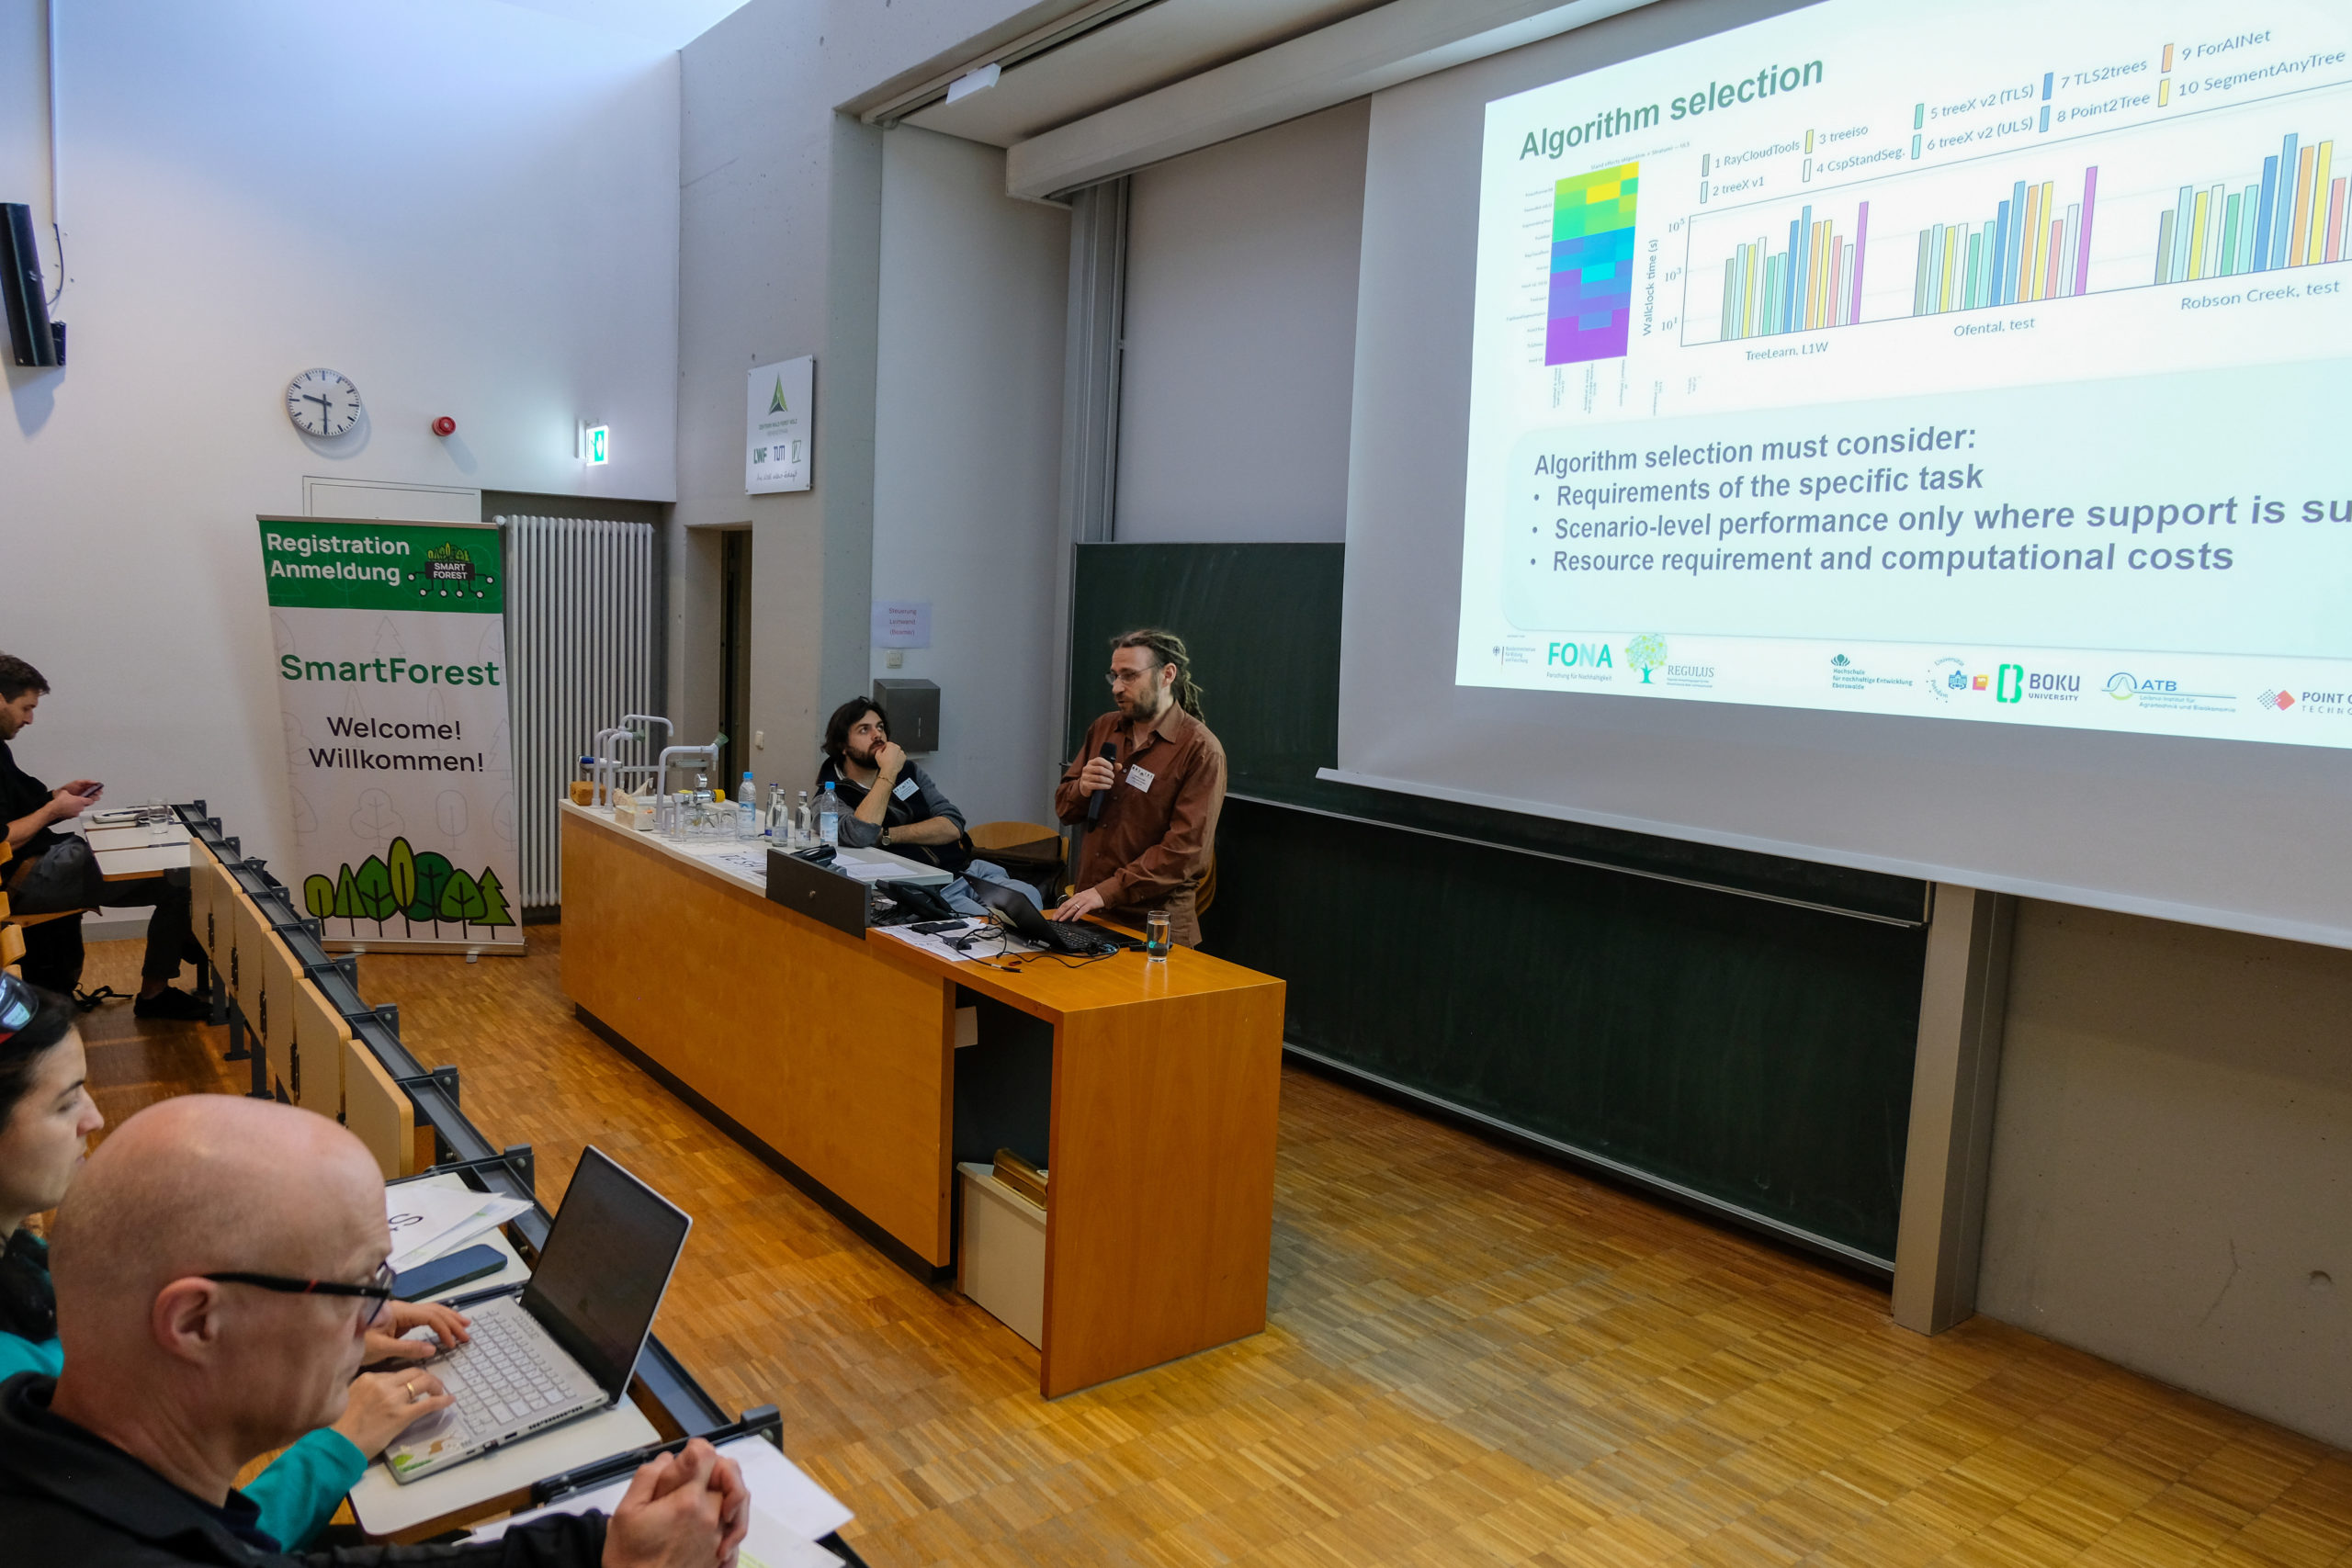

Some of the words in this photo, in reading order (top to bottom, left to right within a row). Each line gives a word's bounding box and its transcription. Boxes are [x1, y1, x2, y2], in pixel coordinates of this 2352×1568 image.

[2182, 48, 2191, 61] 9
[2197, 29, 2272, 57] ForAINet
[2061, 75, 2070, 88] 7
[2074, 58, 2148, 86] TLS2trees
[2178, 82, 2199, 96] 10
[2203, 49, 2346, 90] SegmentAnyTree
[1519, 103, 1659, 161] Algorithm
[1669, 59, 1824, 121] selection
[1930, 107, 1938, 119] 5
[1941, 97, 1976, 117] treeX
[1980, 93, 1996, 107] v2
[2000, 84, 2034, 105] (TLS)
[2057, 109, 2066, 122] 8
[2071, 92, 2151, 120] Point2Tree
[1819, 133, 1826, 144] 3
[1829, 124, 1869, 143] treeiso
[1928, 139, 1936, 151] 6
[1939, 130, 1973, 149] treeX
[1976, 126, 1993, 140] v2
[1996, 116, 2033, 138] (ULS)
[1714, 158, 1720, 169] 1
[1724, 139, 1800, 167] RayCloudTools
[1816, 163, 1824, 174] 4
[1827, 147, 1905, 174] CspStandSeg.
[1713, 186, 1719, 197] 2
[1722, 177, 1748, 196] treeX
[1750, 176, 1764, 189] v1
[1648, 239, 1658, 252] (s)
[1646, 254, 1657, 279] time
[2181, 293, 2242, 310] Robson
[2246, 286, 2300, 302] Creek,
[2306, 279, 2341, 297] test
[1643, 282, 1655, 336] Wallclock
[1953, 321, 2006, 337] Ofental,
[2009, 317, 2036, 332] test
[1745, 347, 1798, 361] TreeLearn,
[1802, 342, 1829, 355] L1W
[753, 447, 767, 465] LWF
[1534, 450, 1637, 479] Algorithm
[1645, 444, 1753, 468] selection
[1760, 433, 1828, 461] must
[1837, 425, 1975, 457] consider:
[1556, 478, 1711, 510] Requirements
[1719, 474, 1745, 499] of
[1750, 473, 1791, 497] the
[1799, 468, 1909, 502] specific
[1919, 463, 1984, 491] task
[1555, 513, 1712, 539] Scenario-level
[1719, 509, 1889, 540] performance
[1898, 505, 1963, 536] only
[1974, 502, 2075, 529] where
[2086, 496, 2238, 534] support
[2251, 494, 2287, 525] is
[266, 533, 410, 558] Registration
[1554, 549, 1654, 571] Resource
[1661, 546, 1813, 576] requirement
[1820, 547, 1872, 570] and
[1882, 542, 2116, 577] computational
[2127, 541, 2233, 571] costs
[270, 559, 401, 587] Anmeldung
[433, 570, 468, 581] FOREST
[434, 561, 466, 572] SMART
[1547, 641, 1613, 669] FONA
[281, 653, 501, 686] SmartForest
[1668, 664, 1715, 678] REGULUS
[2030, 672, 2080, 693] BOKU
[2029, 693, 2079, 702] UNIVERSITY
[2141, 679, 2177, 692] ATB
[2301, 691, 2344, 704] POINT
[326, 716, 461, 741] Welcome!
[309, 748, 484, 773] Willkommen!
